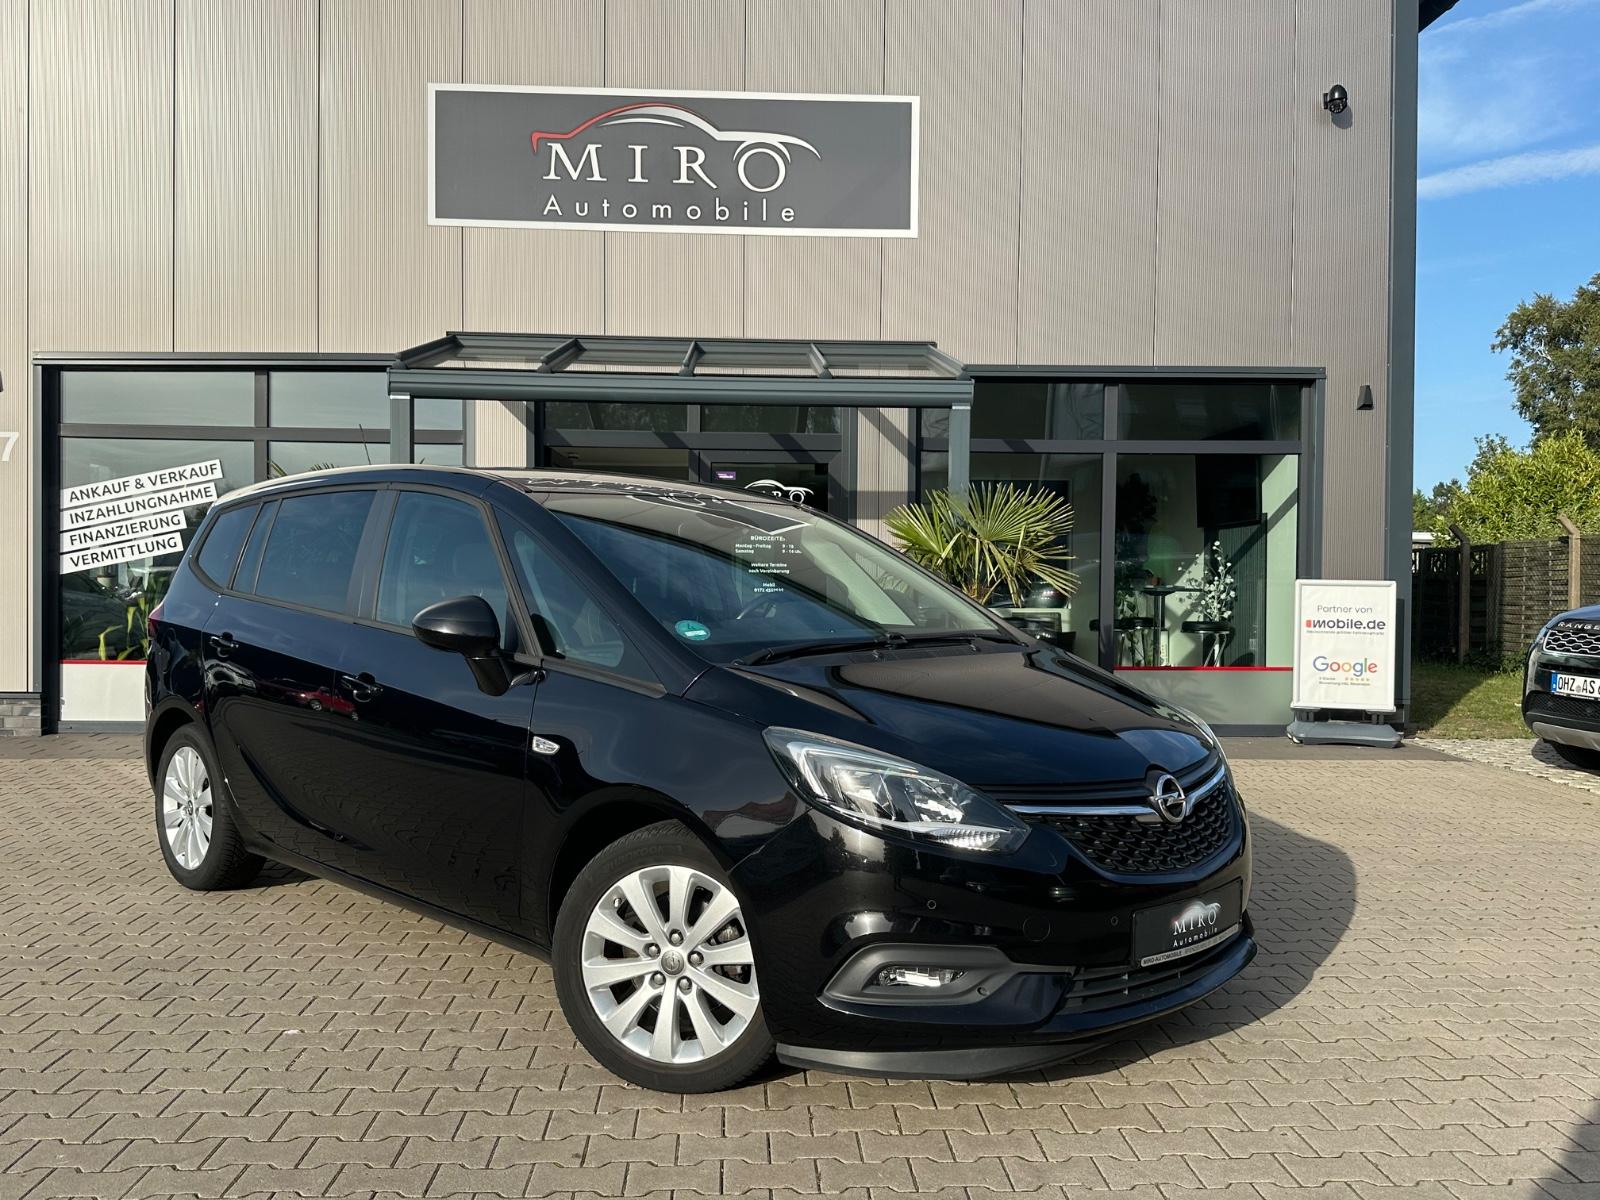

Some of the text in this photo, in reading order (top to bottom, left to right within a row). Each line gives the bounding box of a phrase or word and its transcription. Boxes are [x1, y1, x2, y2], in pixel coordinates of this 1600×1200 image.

[543, 143, 786, 192] MIRO
[543, 194, 796, 221] Automobile
[69, 463, 218, 503] ANKAUF & VERKAUF
[69, 486, 213, 525] INZAHLUNGNAHME
[69, 514, 181, 546] FINANZIERUNG
[69, 536, 178, 568] VERMITTLUNG
[1317, 605, 1353, 613] Partner
[1312, 618, 1386, 630] mobile.de
[1313, 656, 1378, 677] Google
[1558, 676, 1576, 692] OHZ
[1582, 679, 1596, 694] AS
[1173, 908, 1217, 936] MIRO
[1173, 926, 1218, 948] Automobile
